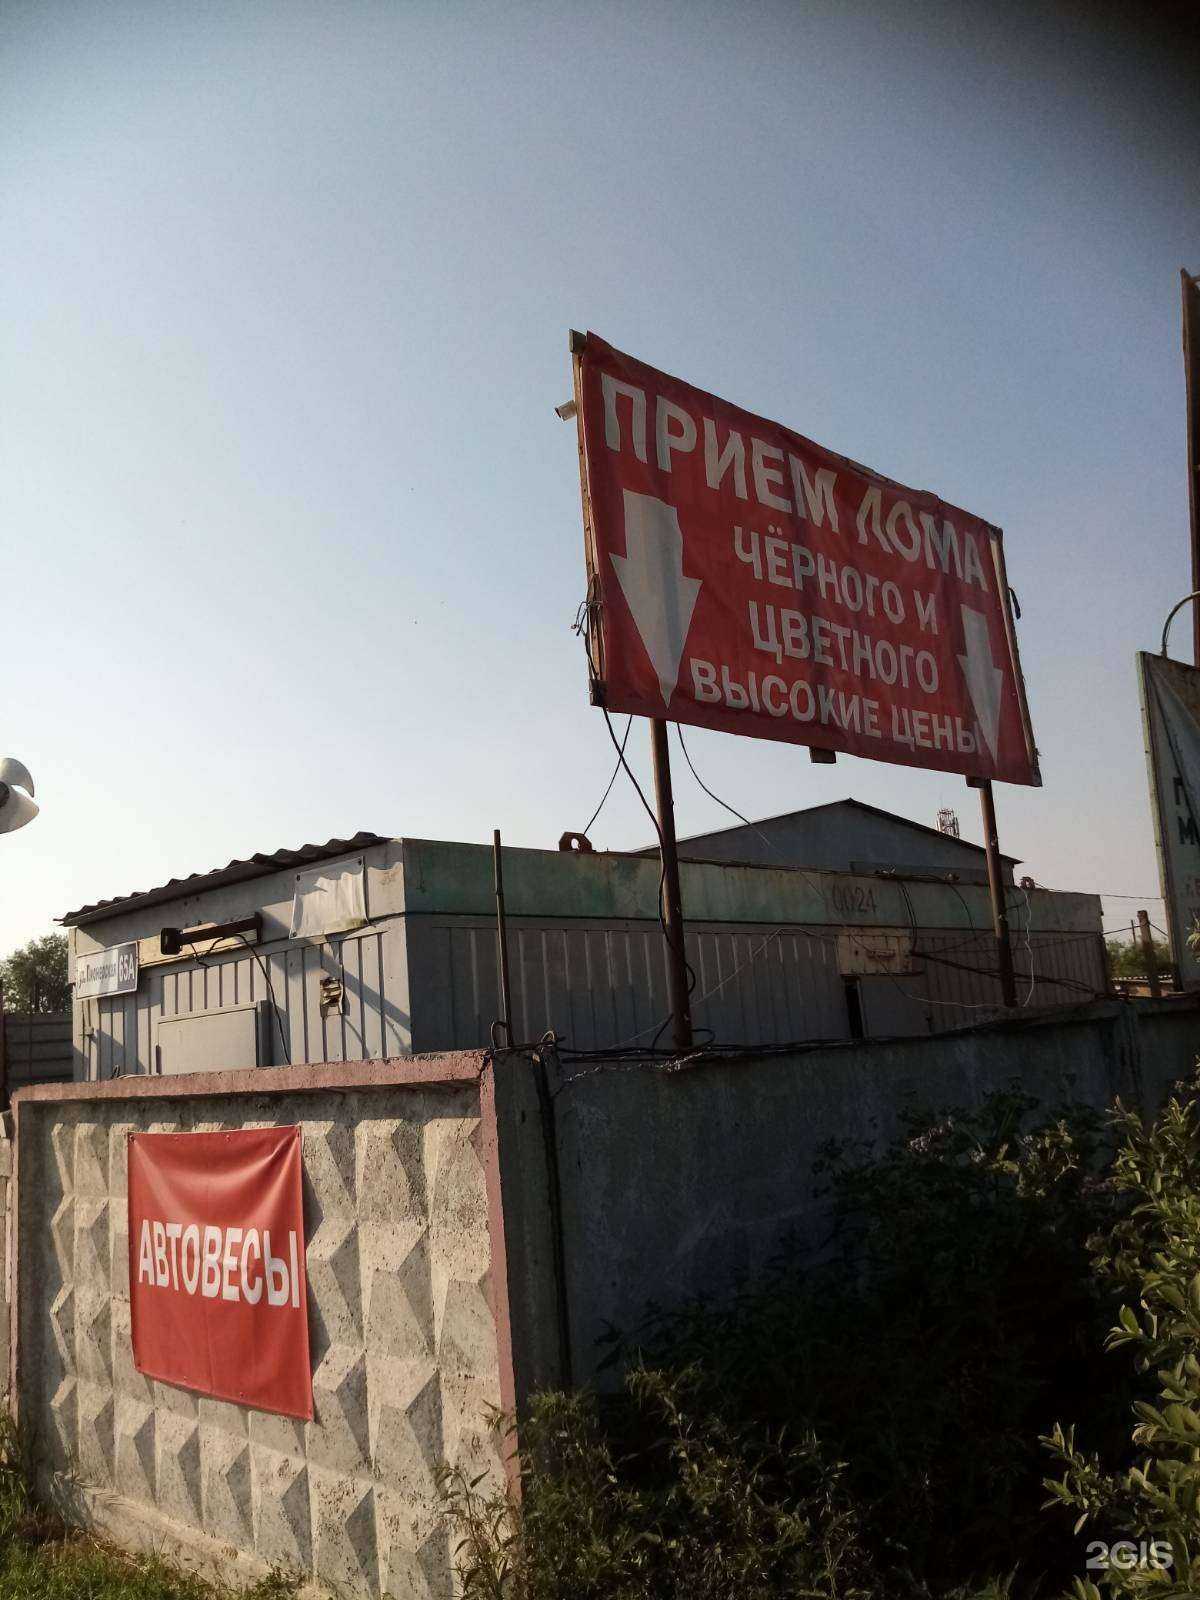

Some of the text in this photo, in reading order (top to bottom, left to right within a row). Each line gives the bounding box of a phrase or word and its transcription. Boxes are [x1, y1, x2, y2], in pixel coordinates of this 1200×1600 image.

[601, 372, 989, 592] ПРИЕМ ЛОМА
[734, 526, 939, 635] ЧЁРНОГО И
[748, 600, 940, 695] ЦВЕТНОГО
[689, 658, 882, 738] ВЫСОКИЕ
[118, 954, 135, 982] 65А
[138, 1219, 300, 1308] АВТОВЕСЫ
